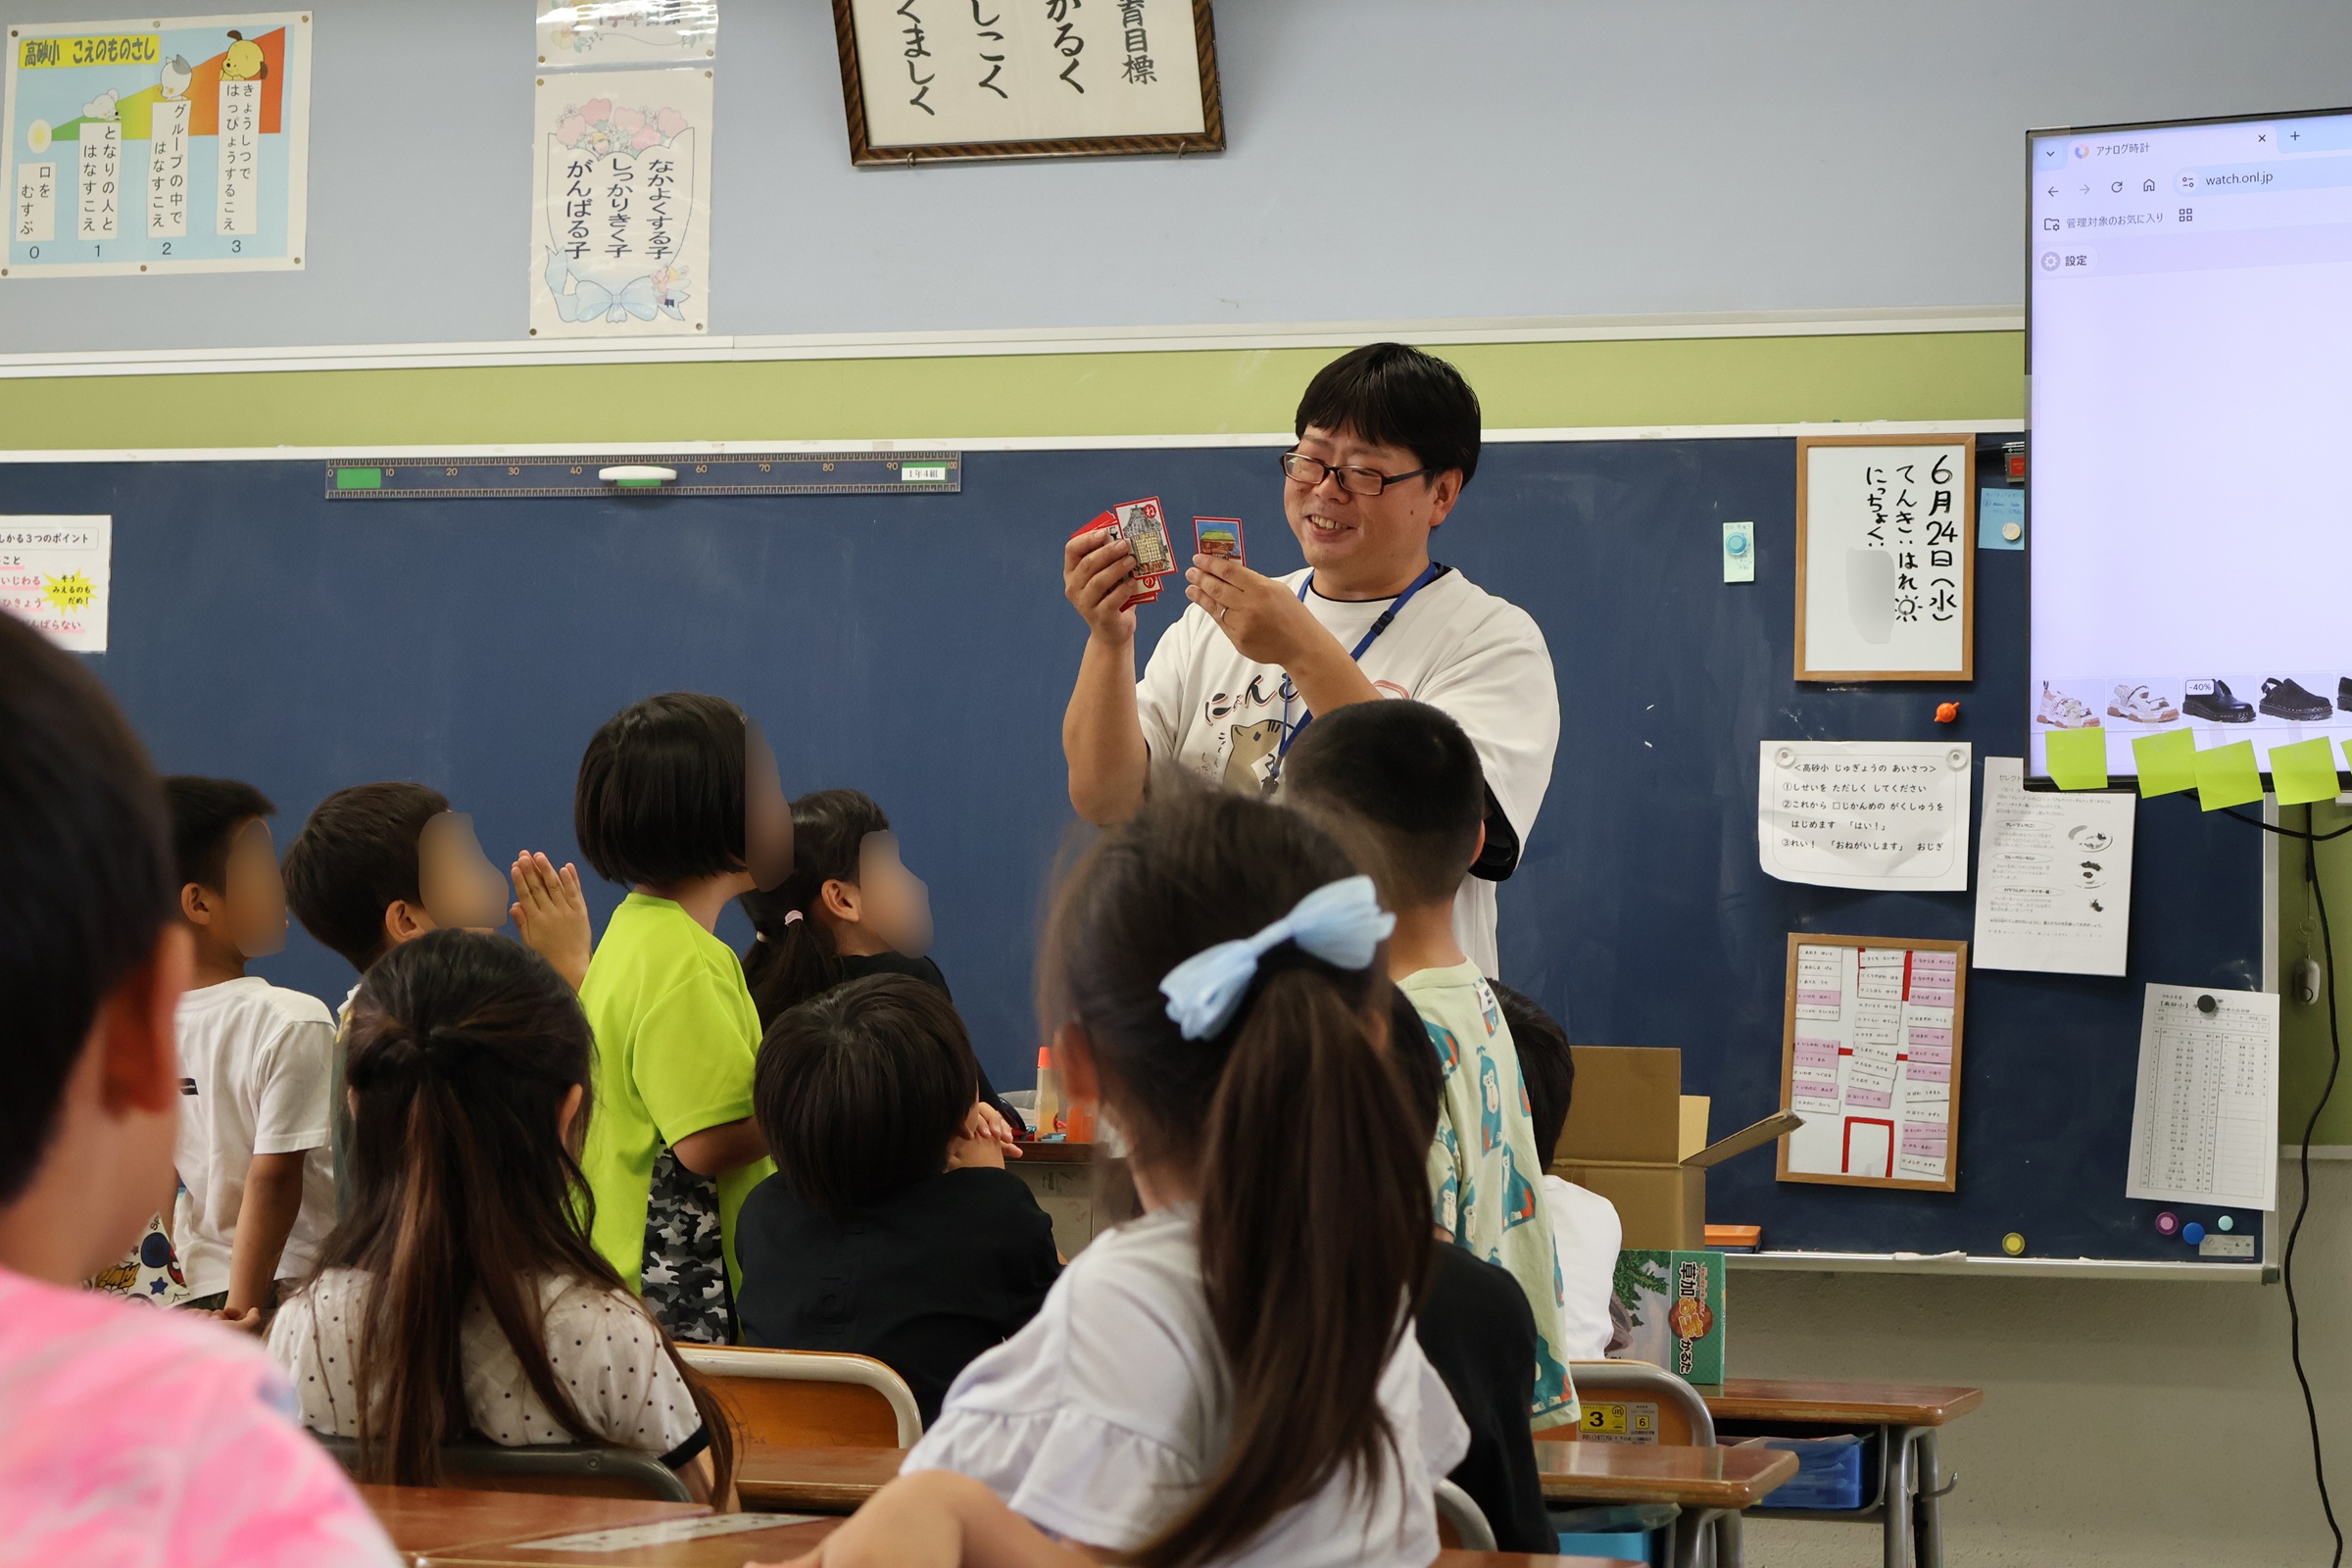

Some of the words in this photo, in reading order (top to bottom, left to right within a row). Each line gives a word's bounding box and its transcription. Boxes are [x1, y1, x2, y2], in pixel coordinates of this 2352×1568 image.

[24, 40, 60, 67] 高砂小
[73, 37, 156, 64] こえのものさし
[239, 84, 254, 179] きょうしつで
[223, 83, 240, 231] はっぴょうするこえ
[2096, 142, 2150, 157] アナログ時計
[170, 103, 186, 224] グループの中で
[101, 125, 117, 231] となりの人と
[151, 142, 167, 227] はなすこえ
[2206, 172, 2274, 186] watch.onl.jp
[83, 144, 97, 232] はなすこえ
[21, 184, 34, 235] むすぶ
[564, 160, 593, 260] がんばる子
[605, 158, 634, 259] しっかりきく子
[645, 159, 674, 260] なかよくする子
[2066, 212, 2164, 228] 管理対象のお気に入り
[29, 246, 40, 259] 0
[94, 245, 101, 257] 1
[162, 243, 172, 255] 2
[231, 240, 241, 253] 3
[2065, 255, 2087, 267] 設定
[327, 468, 334, 478] 0
[385, 467, 395, 477] 10
[446, 467, 458, 476] 20
[508, 466, 519, 476] 30
[570, 466, 582, 475] 40
[696, 464, 708, 473] 60
[759, 463, 770, 472] 70
[822, 463, 834, 472] 80
[886, 462, 899, 470] 90
[1145, 507, 1155, 517] ね
[0, 556, 21, 565] こと
[1835, 763, 1887, 773] じゅぎょうの
[1874, 784, 1927, 793] してください
[1889, 803, 1944, 811] がくしゅうを
[1791, 820, 1836, 829] はじめます
[1590, 1411, 1604, 1427] 3
